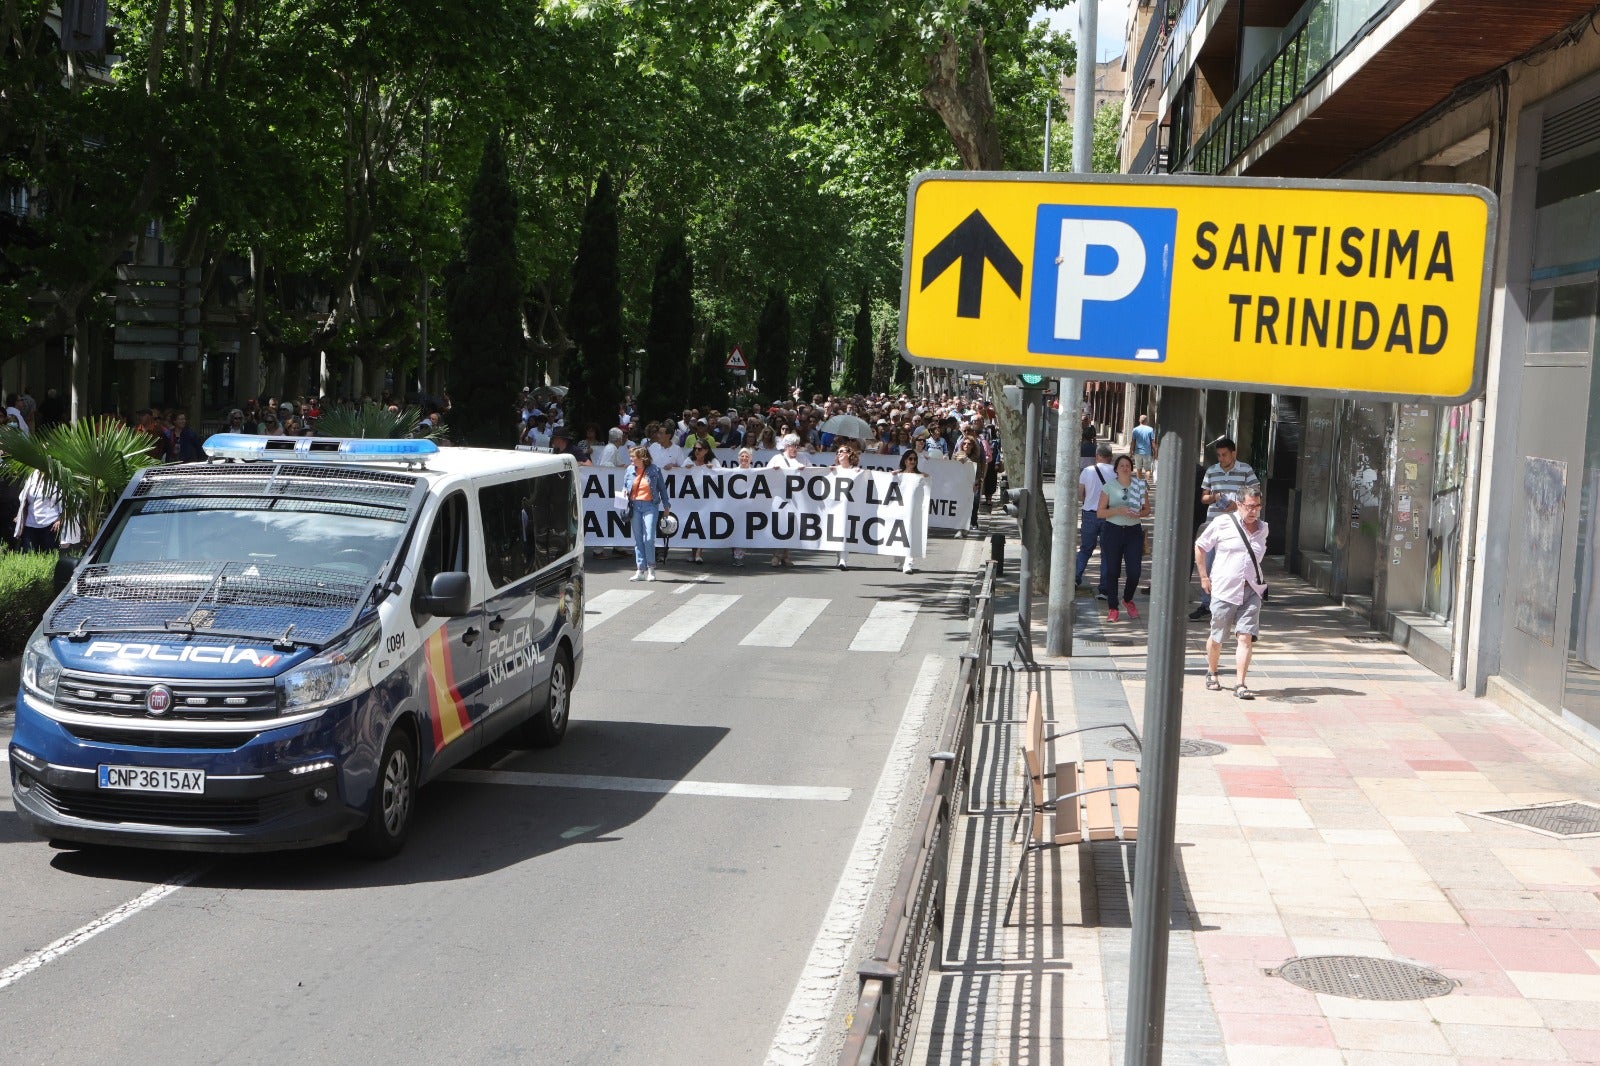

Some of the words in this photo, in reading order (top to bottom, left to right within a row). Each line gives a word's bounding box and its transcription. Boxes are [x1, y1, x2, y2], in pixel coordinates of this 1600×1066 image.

[1053, 218, 1146, 340] P
[1191, 220, 1455, 282] SANTISIMA
[1228, 293, 1449, 355] TRINIDAD
[785, 475, 855, 503] POR
[865, 479, 905, 507] LA
[745, 501, 911, 549] PÚBLICA
[488, 642, 546, 689] NACIONAL
[151, 694, 166, 707] FIAT
[107, 768, 202, 791] CNP3615AX
